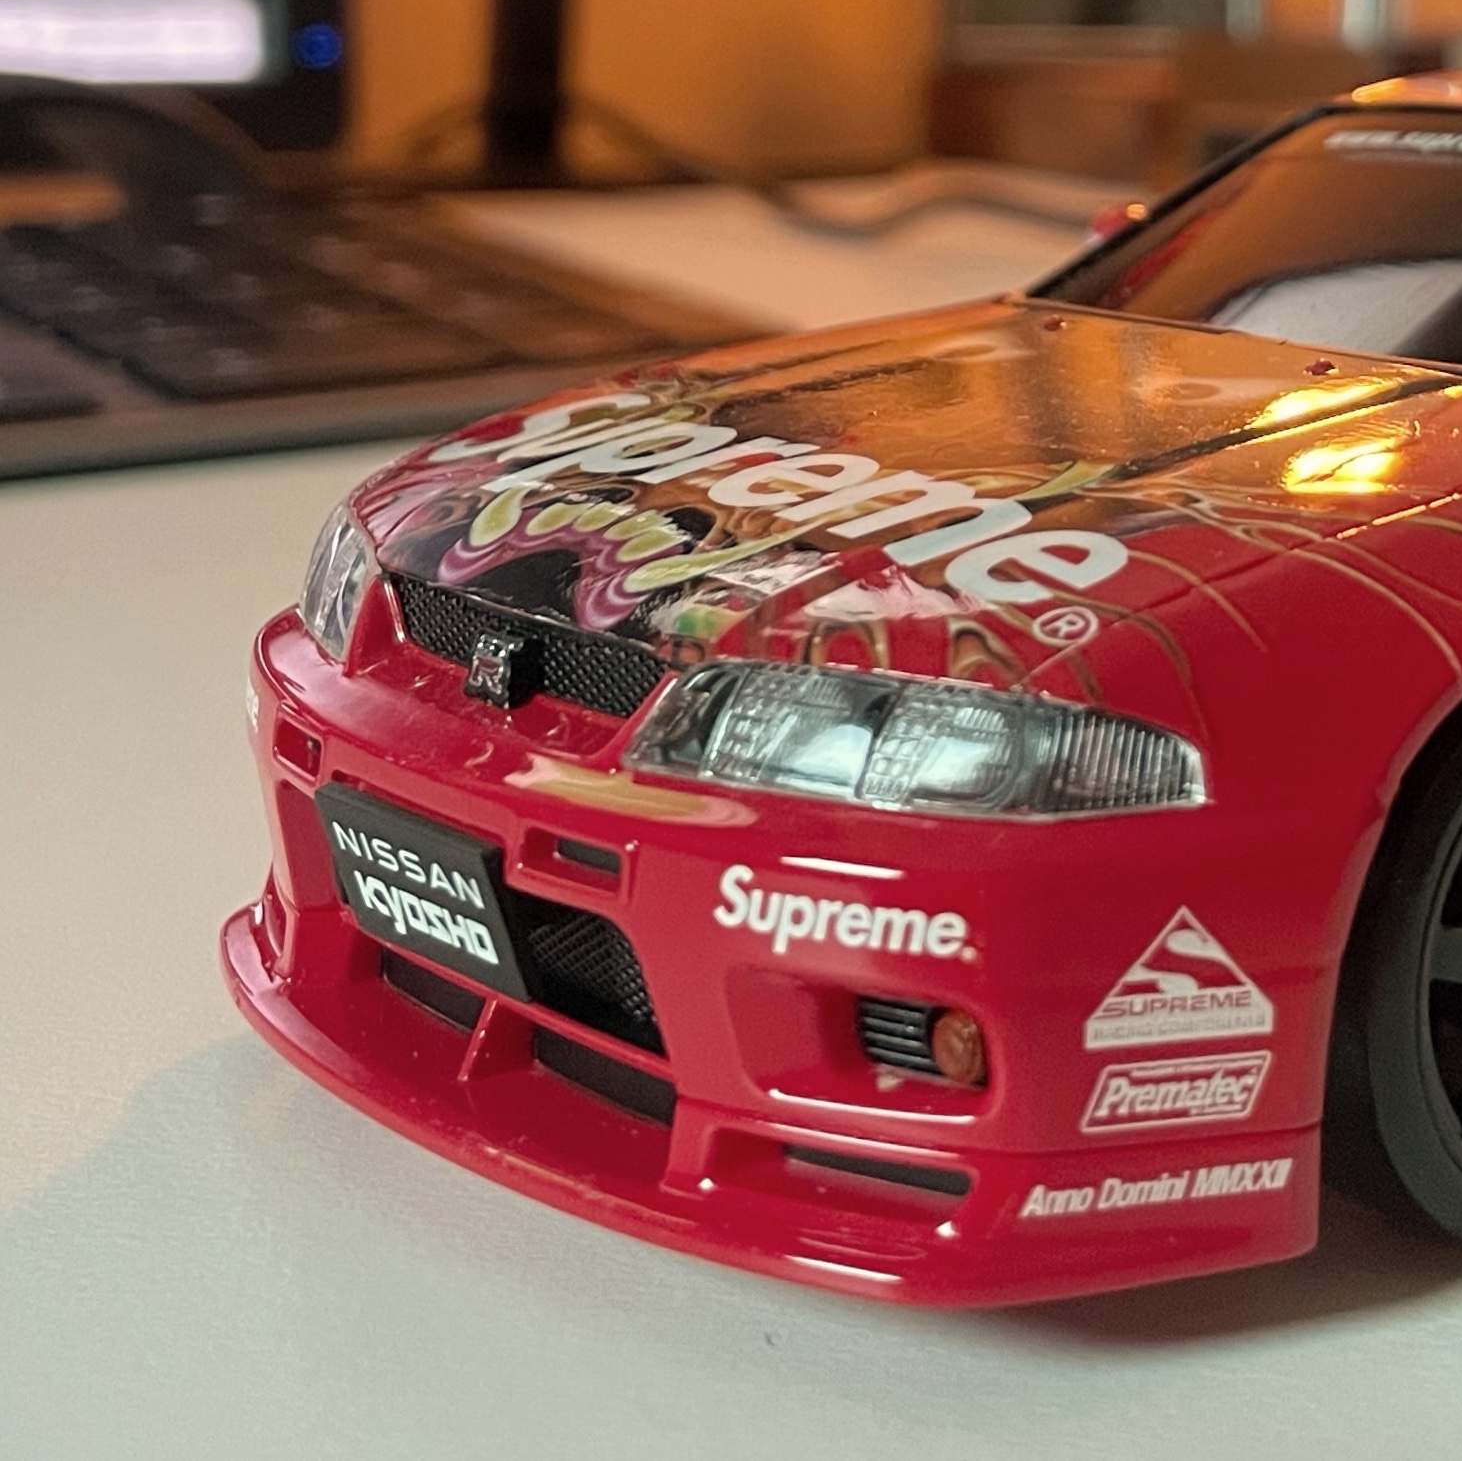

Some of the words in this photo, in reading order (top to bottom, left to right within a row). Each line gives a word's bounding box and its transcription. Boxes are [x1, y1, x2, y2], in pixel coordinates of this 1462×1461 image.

[428, 392, 1129, 604] Supreme
[331, 820, 486, 910] NISSAN
[353, 869, 500, 965] KYOSHO
[1096, 990, 1253, 1020] SUPREME
[1017, 1183, 1095, 1218] Anno
[1097, 1169, 1191, 1210] Domini
